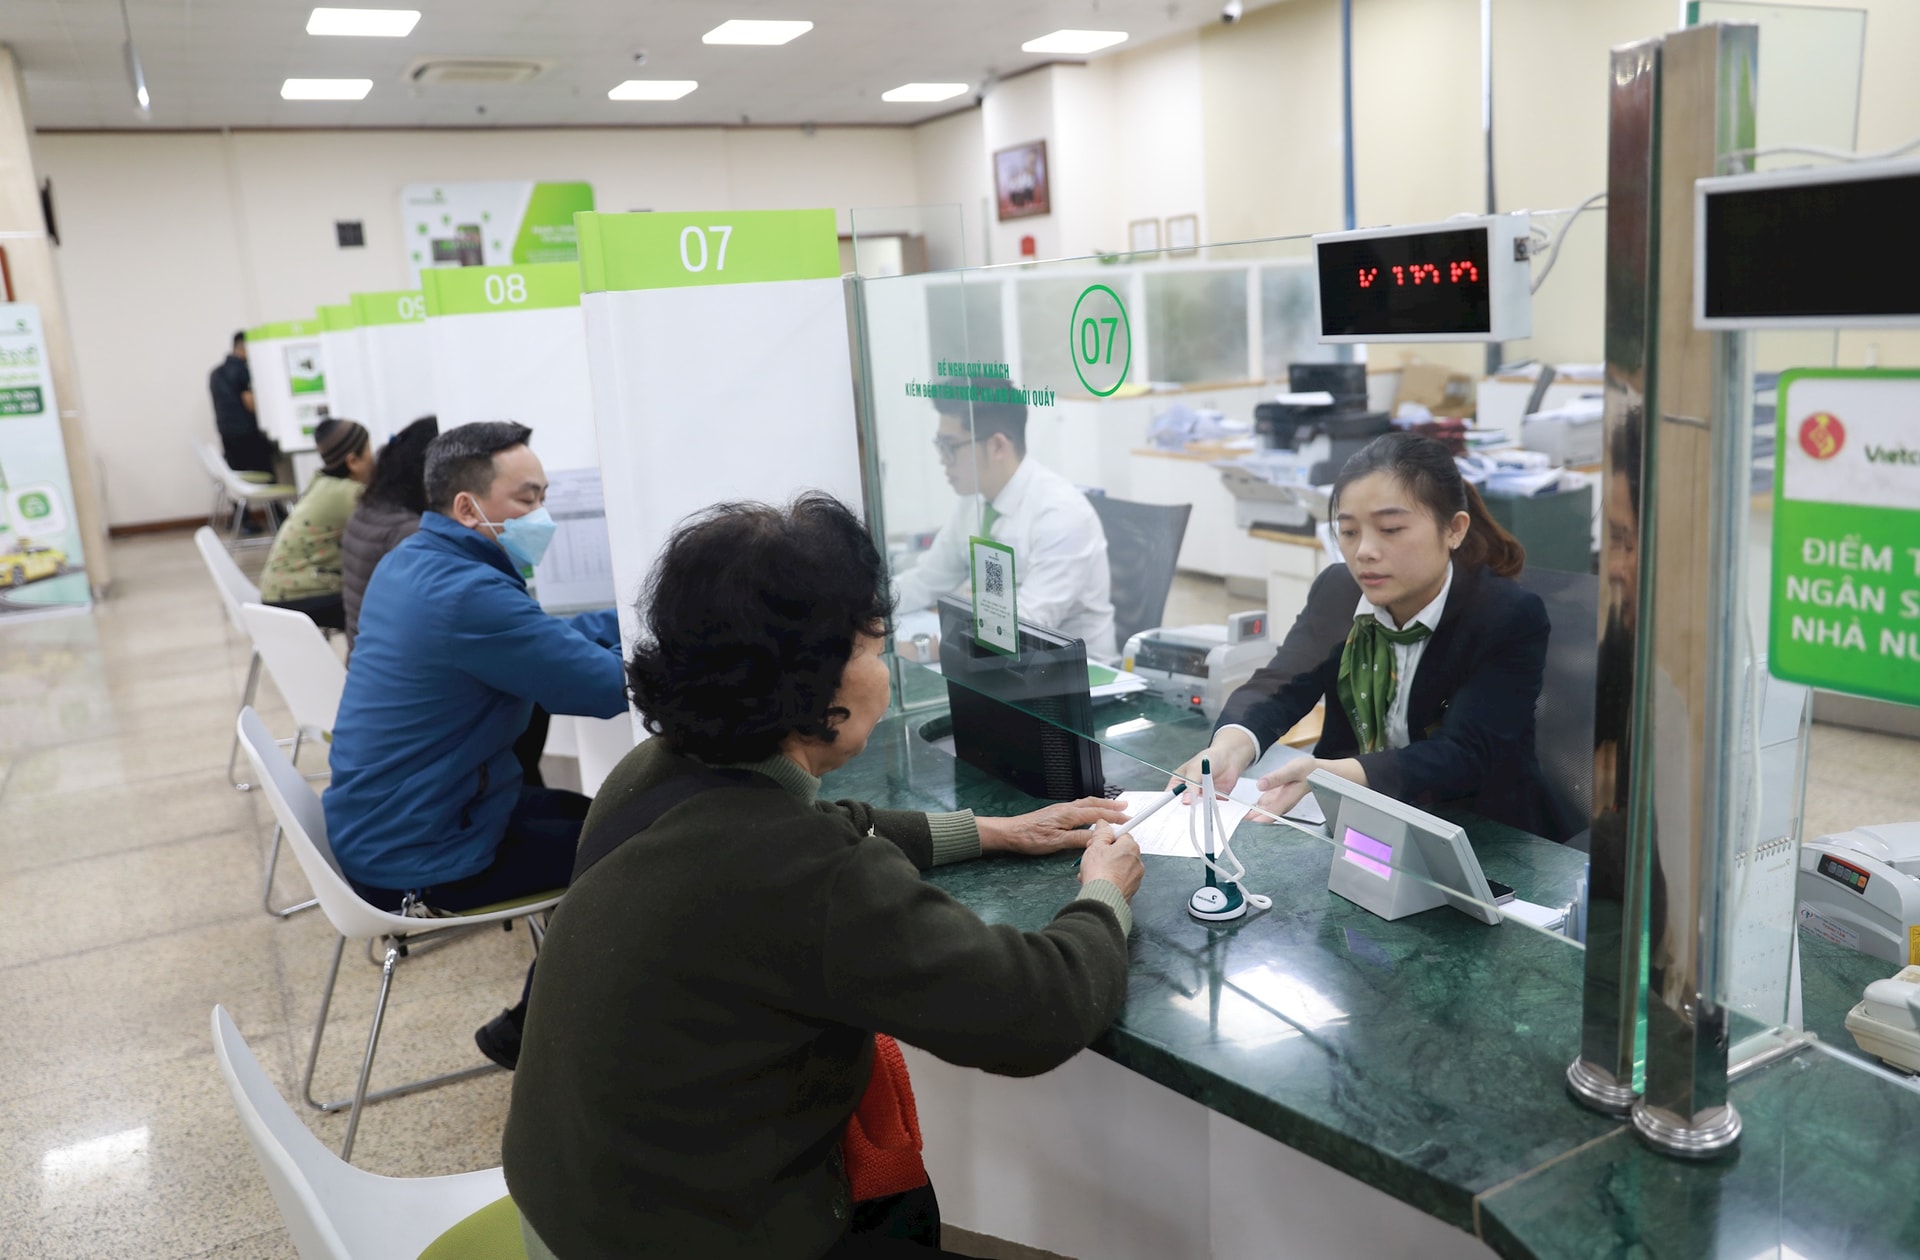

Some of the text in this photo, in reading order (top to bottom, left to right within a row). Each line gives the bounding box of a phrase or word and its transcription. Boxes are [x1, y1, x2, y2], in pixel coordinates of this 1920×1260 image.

[680, 225, 733, 272] 07
[484, 273, 528, 305] 08
[1080, 317, 1119, 365] 07
[983, 360, 1010, 379] KHÁCH
[1786, 574, 1920, 619] NGÂN S
